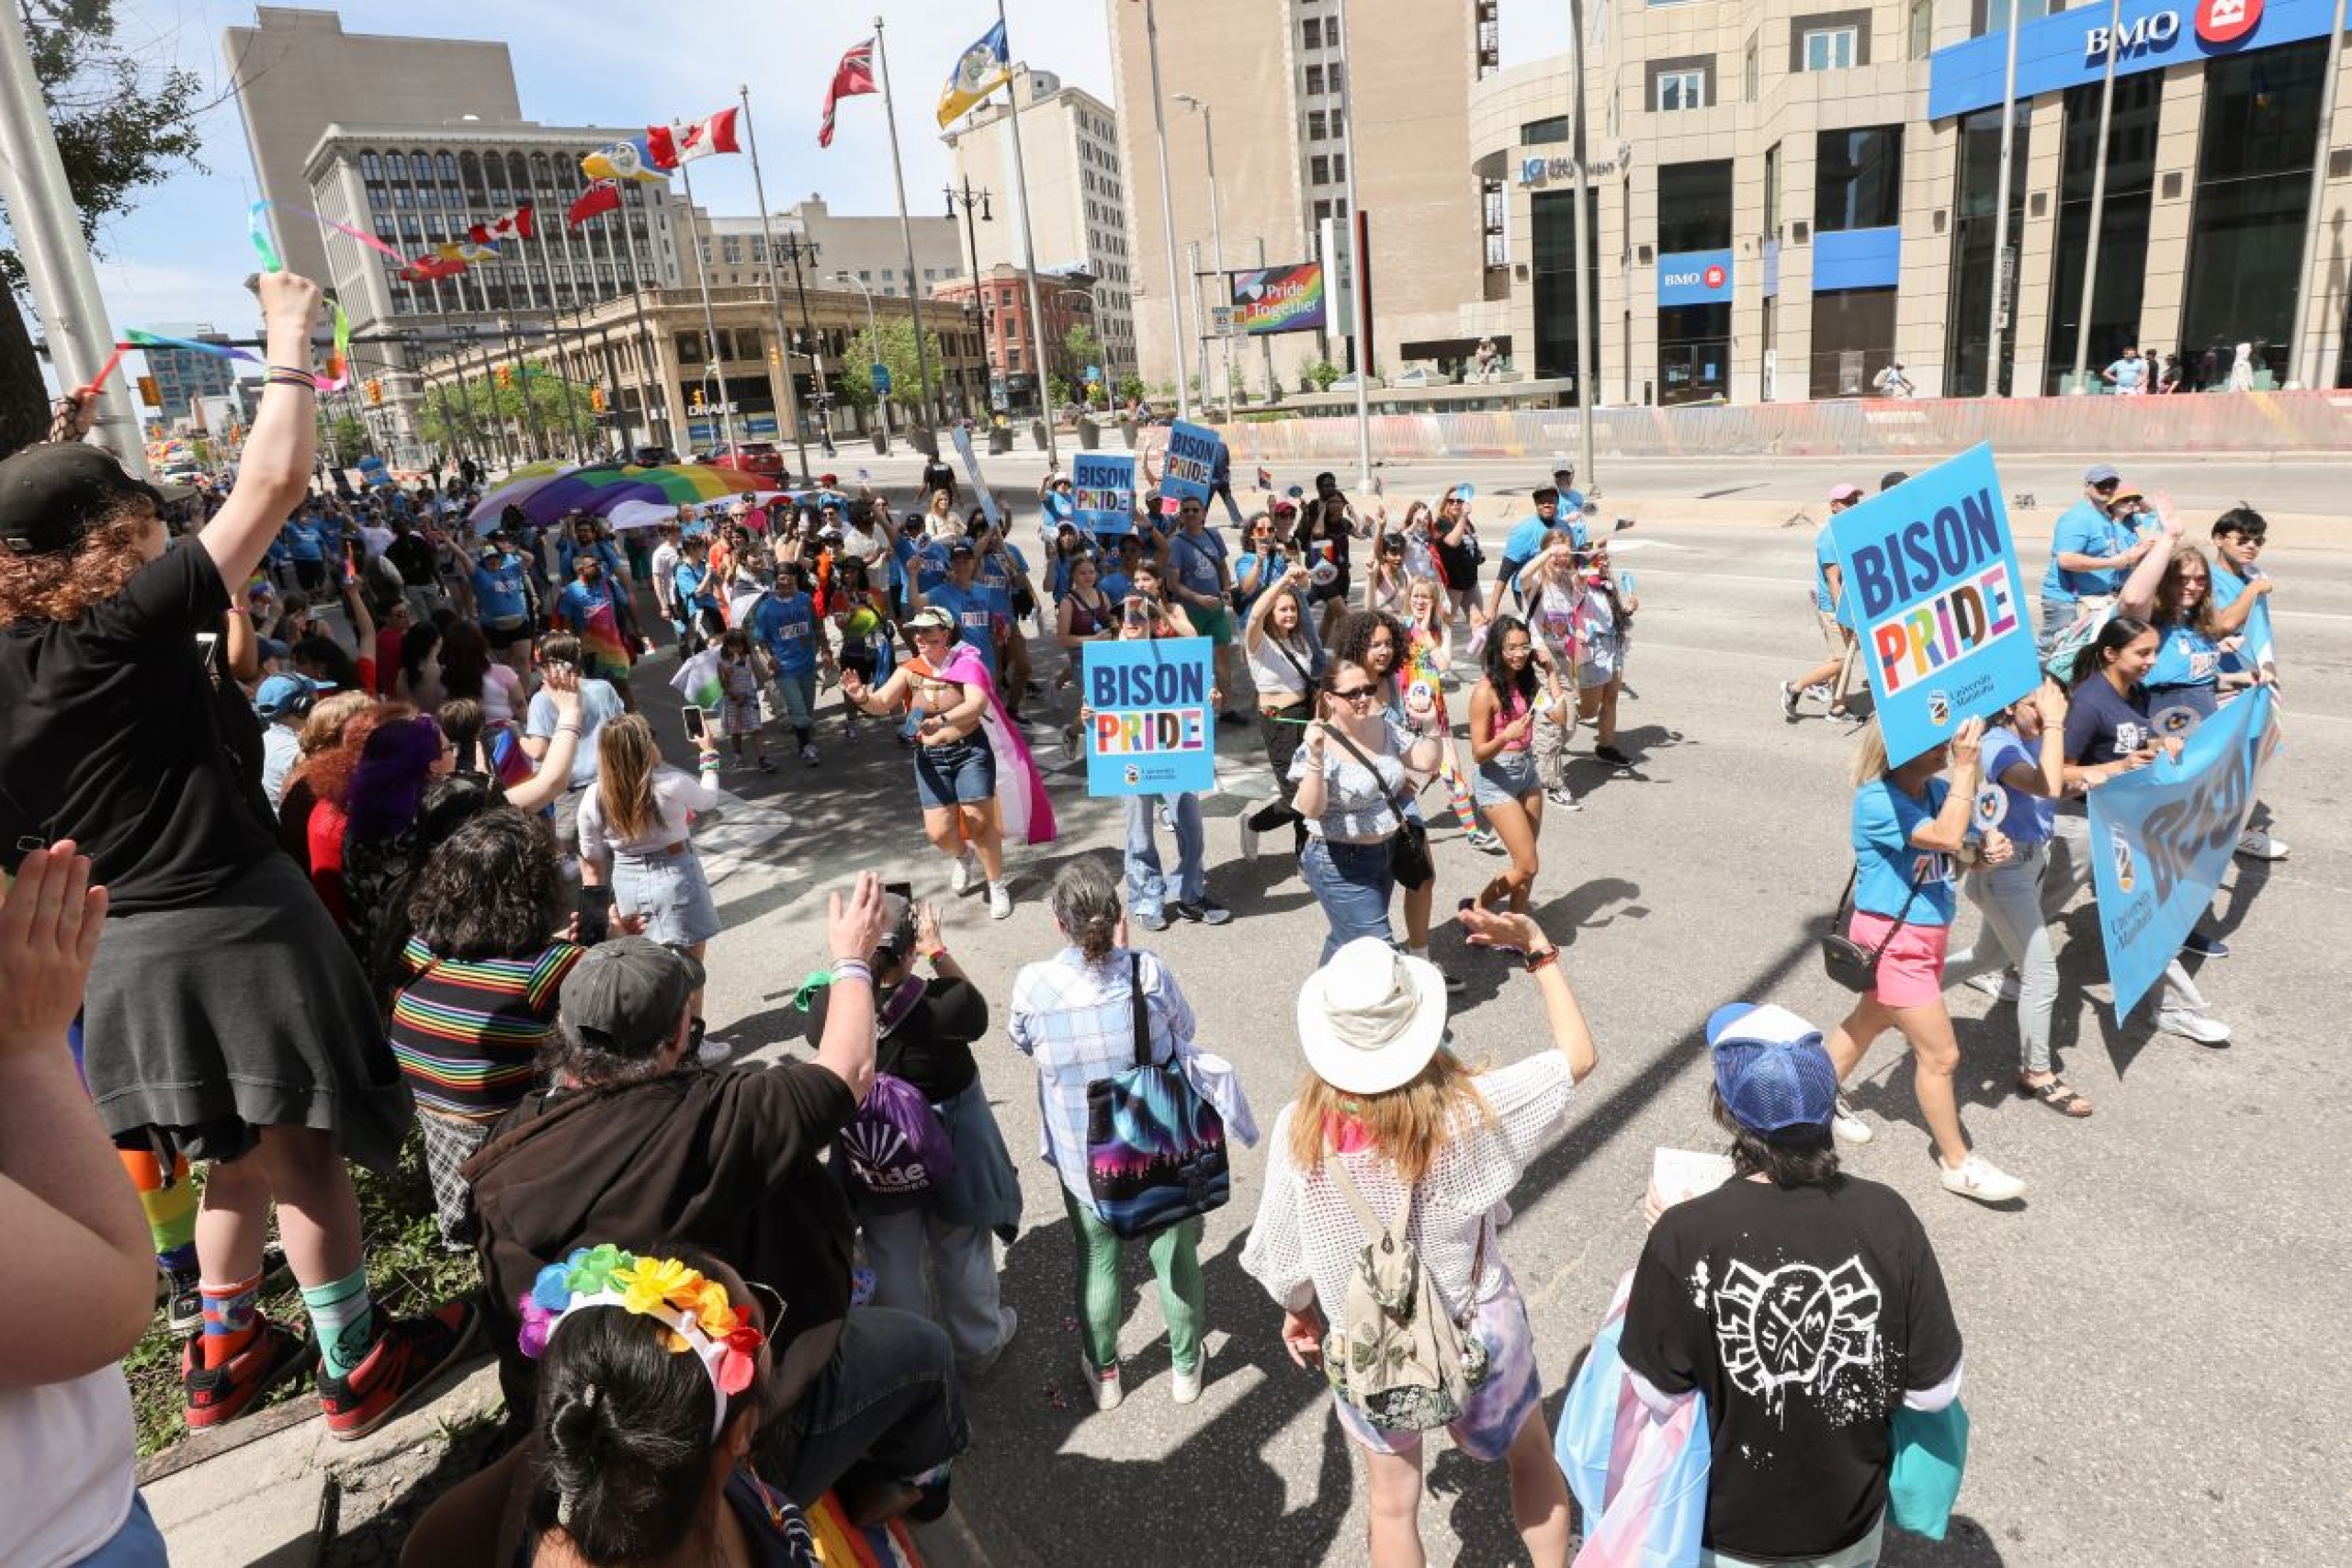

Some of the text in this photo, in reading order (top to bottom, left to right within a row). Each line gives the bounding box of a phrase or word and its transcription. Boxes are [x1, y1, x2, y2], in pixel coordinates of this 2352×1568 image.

[2085, 10, 2179, 56] BMO
[1267, 280, 1305, 299] Pride
[1665, 272, 1700, 287] BMO
[1253, 299, 1316, 321] Together
[1172, 432, 1215, 462] BISON
[1078, 466, 1131, 489] BISON
[1169, 456, 1210, 485] PRIDE
[1077, 489, 1130, 510] PRIDE
[1850, 487, 2002, 620] BISON
[1874, 566, 2017, 692] PRIDE
[1091, 661, 1204, 708] BISON
[1098, 710, 1204, 753] PRIDE
